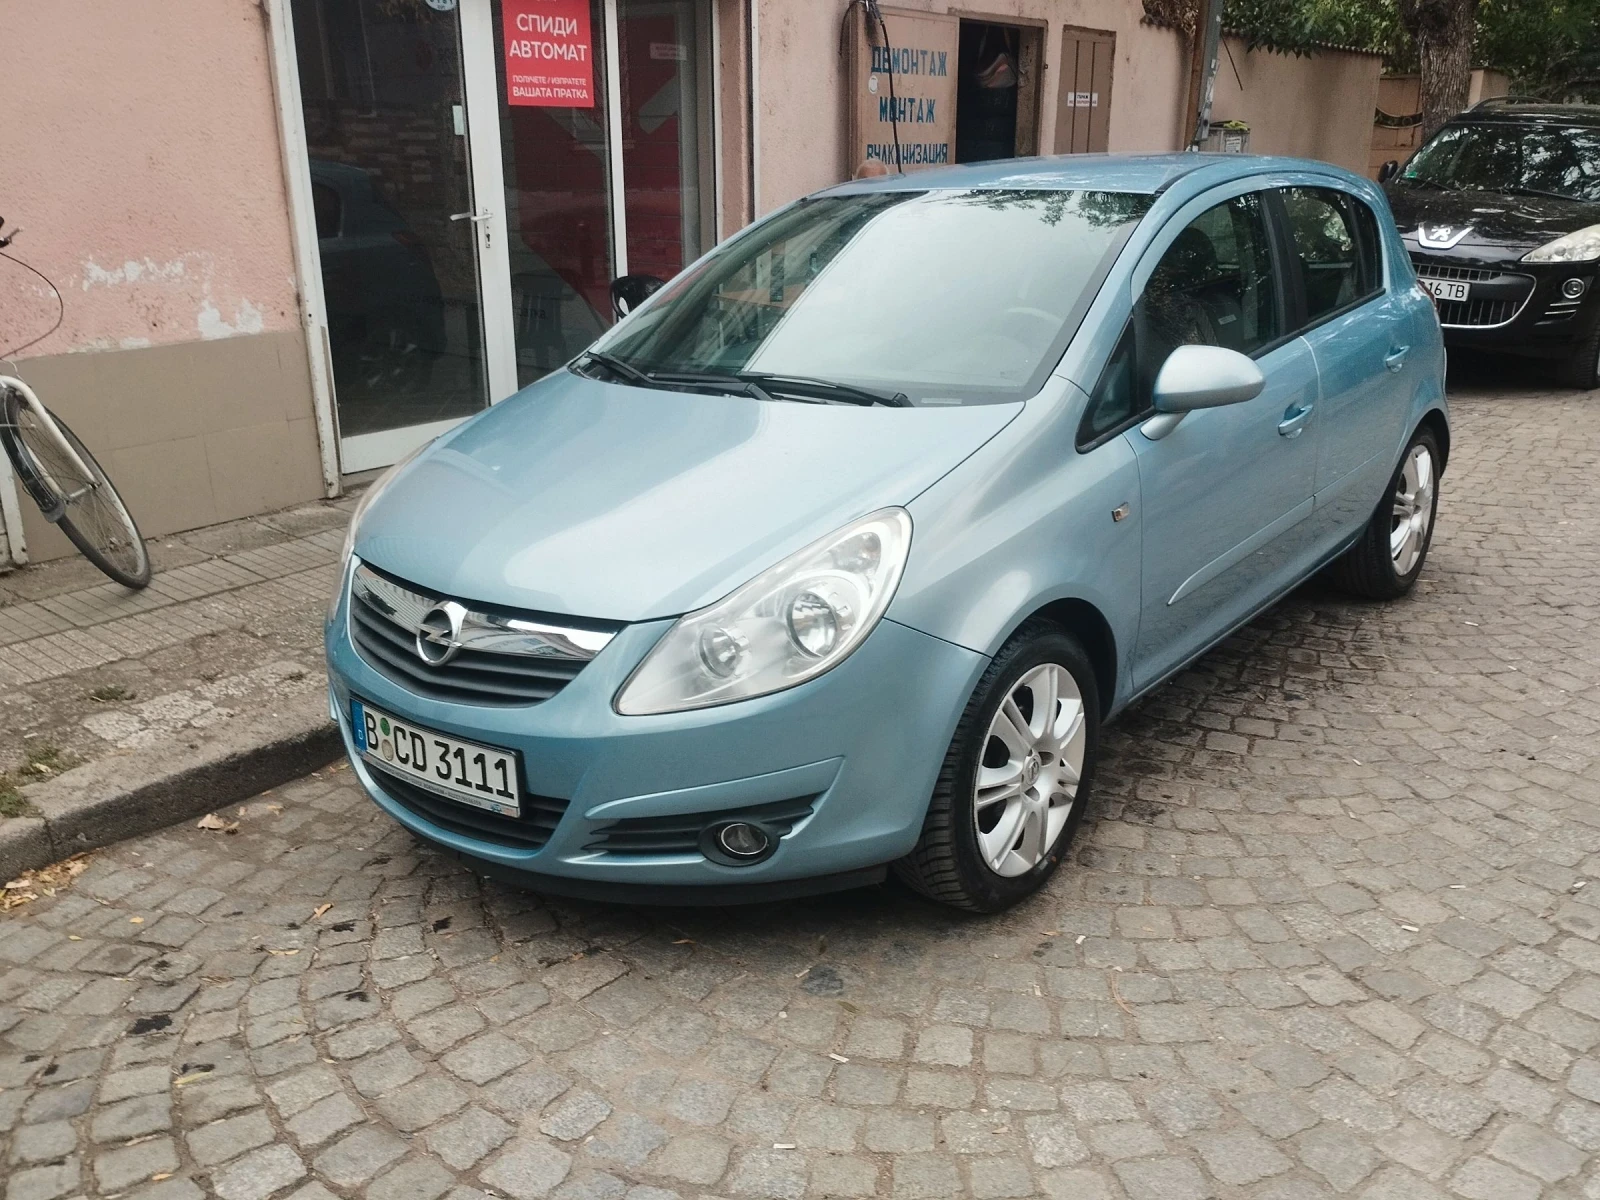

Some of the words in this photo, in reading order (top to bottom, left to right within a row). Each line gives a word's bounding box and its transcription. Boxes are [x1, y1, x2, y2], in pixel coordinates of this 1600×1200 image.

[516, 13, 578, 38] СПИДИ
[509, 39, 588, 62] АВТОМАТ
[871, 46, 947, 77] ДЕМОНТАЖ
[512, 74, 546, 84] ПОЛУЧЕТЕ
[551, 76, 587, 86] ИЗПРАТЕТЕ
[512, 86, 553, 98] ВАШАТА
[553, 87, 589, 99] ПРАТКА
[879, 95, 936, 123] МОНТАЖ
[1422, 281, 1442, 296] 16
[1447, 283, 1465, 298] TB
[364, 710, 379, 751] B
[393, 725, 427, 773] CD
[434, 739, 515, 800] 3111
